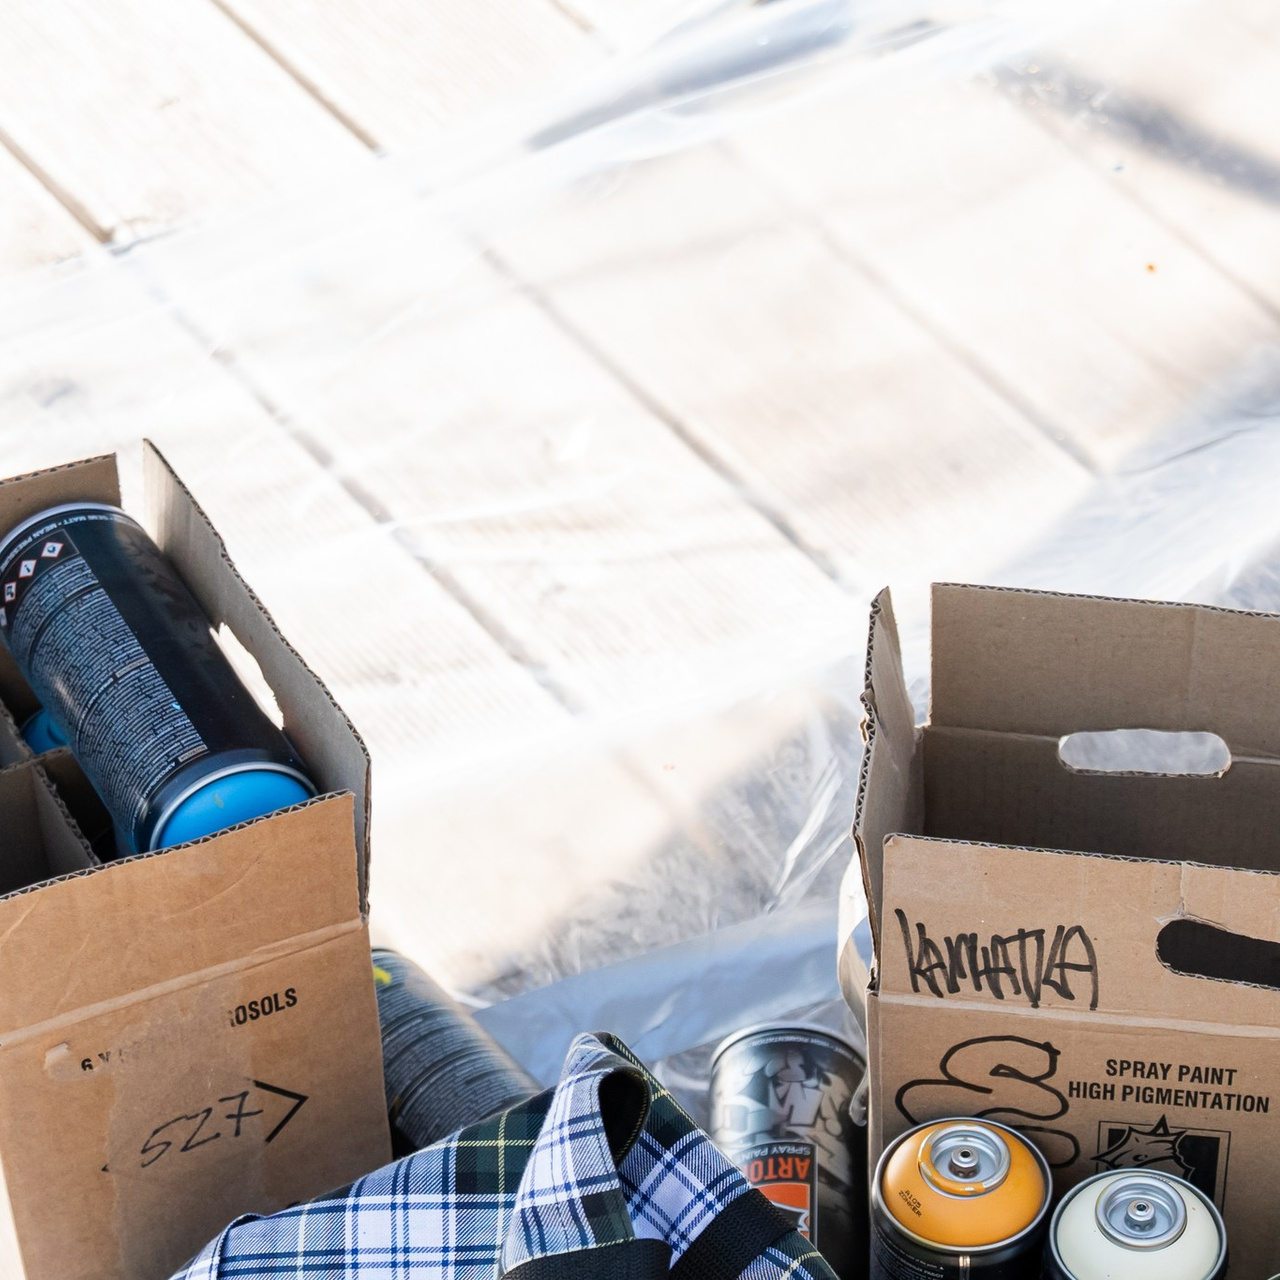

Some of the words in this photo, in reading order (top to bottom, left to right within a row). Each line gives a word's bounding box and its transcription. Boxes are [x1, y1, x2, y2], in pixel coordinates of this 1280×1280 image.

[1106, 1058, 1172, 1080] SPRAY
[1178, 1063, 1238, 1086] PAINT
[1068, 1081, 1116, 1101] HIGH
[1121, 1083, 1270, 1114] PIGMENTATION
[769, 1144, 811, 1156] SPRAY
